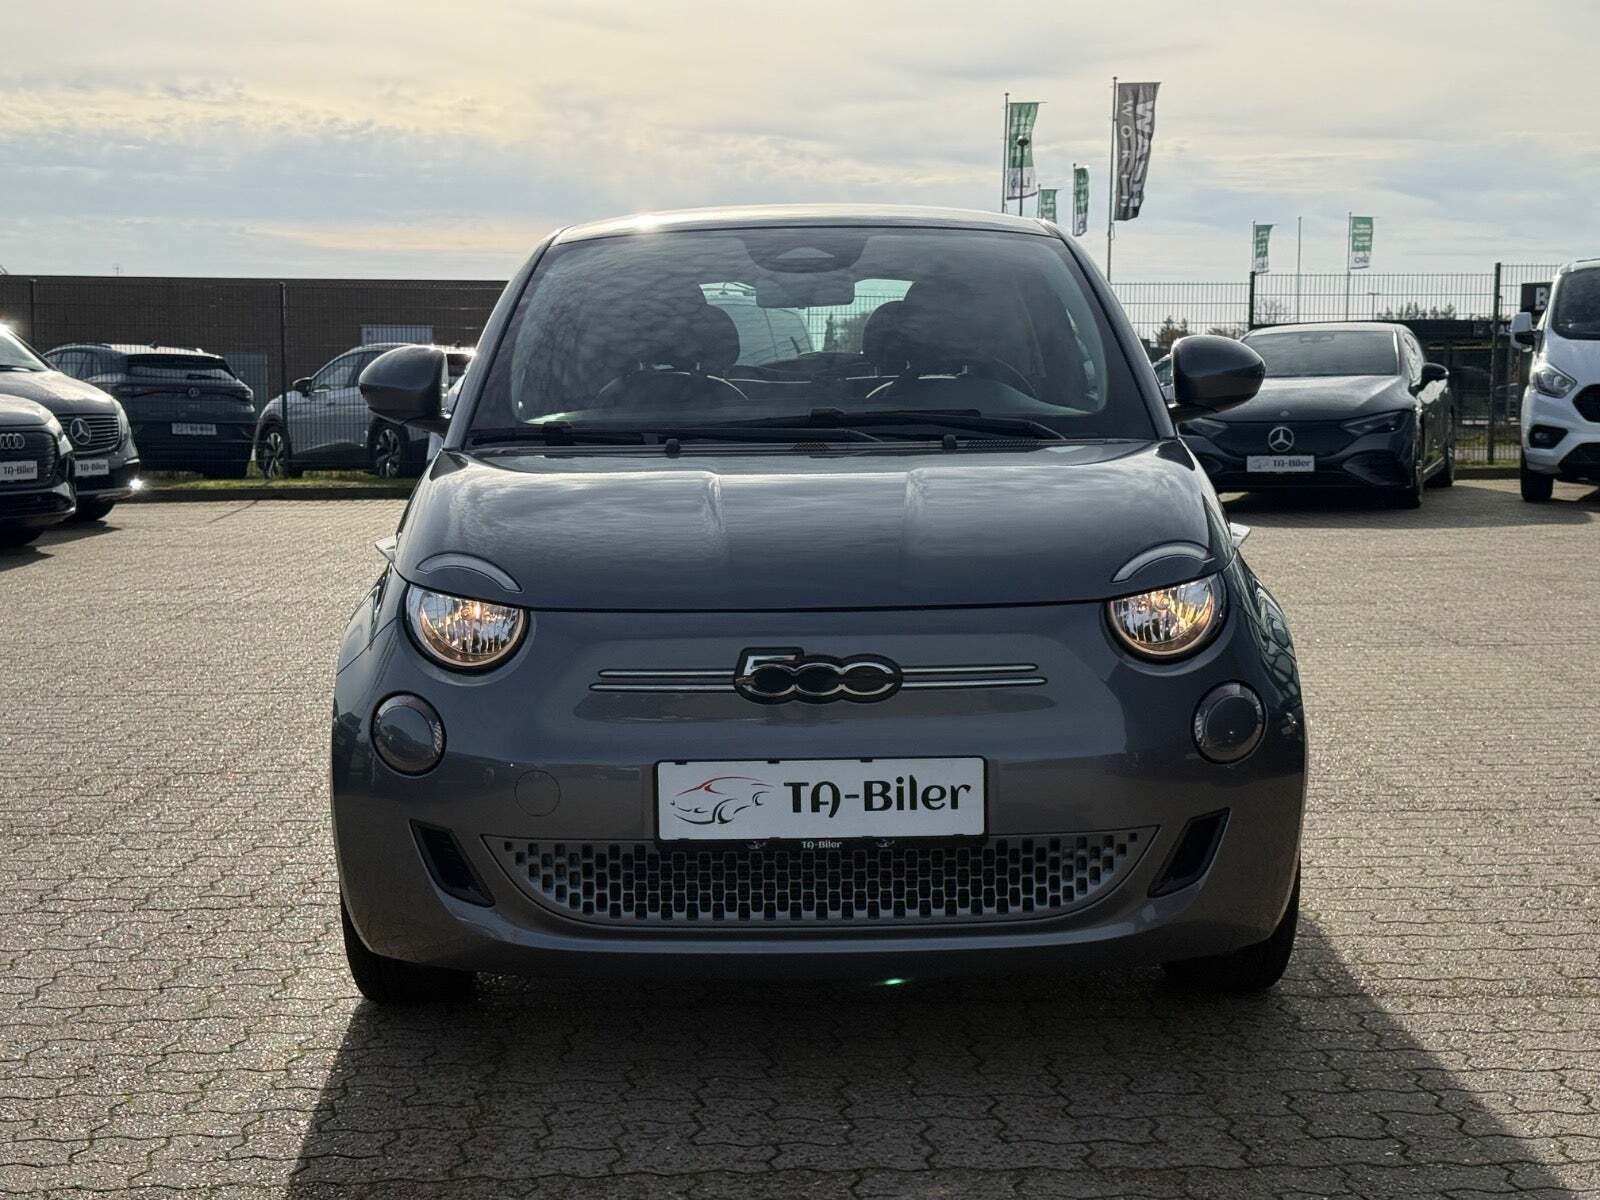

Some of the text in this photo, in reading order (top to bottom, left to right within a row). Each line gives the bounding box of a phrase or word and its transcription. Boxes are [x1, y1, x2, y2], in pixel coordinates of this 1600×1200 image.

[736, 652, 898, 700] 500
[783, 774, 971, 818] TA-Biler
[801, 840, 843, 849] TA-Biler
